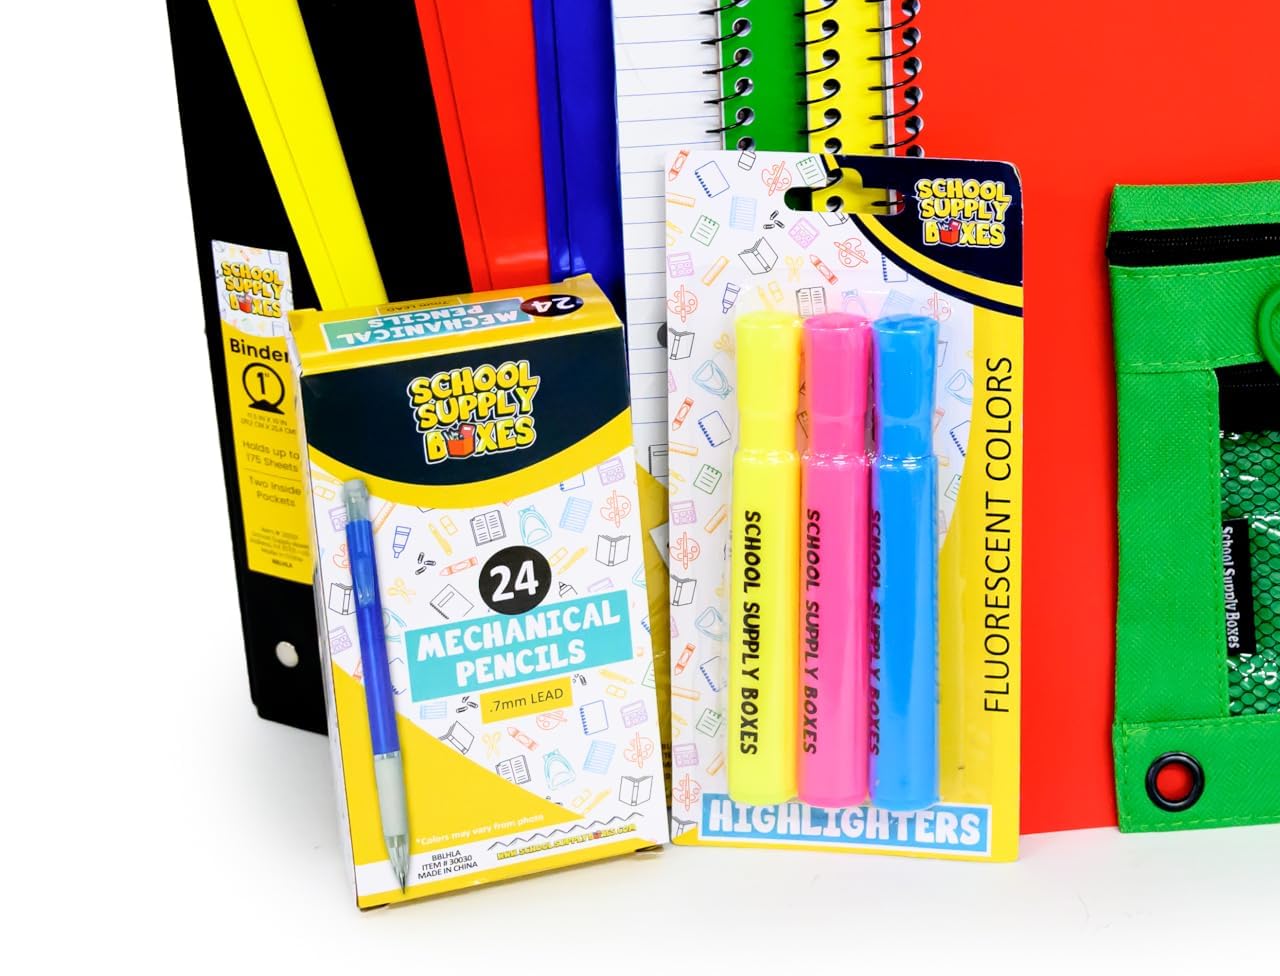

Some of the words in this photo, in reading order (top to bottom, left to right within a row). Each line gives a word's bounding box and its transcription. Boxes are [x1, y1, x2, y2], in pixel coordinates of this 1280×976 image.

[915, 178, 1012, 204] SCHOOL
[920, 198, 1008, 223] SUPPLY
[221, 261, 284, 286] SCHOOL
[224, 277, 284, 300] SUPPLY
[367, 304, 484, 329] PENCILS
[532, 294, 576, 311] 24
[336, 310, 519, 346] MECHANICAL
[408, 361, 540, 407] SCHOOL
[416, 386, 537, 431] SUPPLY
[985, 356, 1013, 482] COLORS
[242, 440, 270, 454] Holds
[272, 449, 287, 459] up
[289, 451, 300, 460] to
[246, 453, 261, 464] 175
[264, 457, 299, 473] Sheets
[248, 476, 269, 488] Two
[256, 490, 296, 507] Pockets
[742, 510, 761, 593] SCHOOL
[805, 510, 821, 592] SCHOOL
[870, 510, 881, 592] SCHOOL
[1222, 526, 1234, 566] School
[489, 559, 539, 602] 24
[983, 491, 1012, 713] FLUORESCENT
[416, 599, 621, 662] MECHANICAL
[741, 601, 761, 681] SUPPLY
[804, 601, 820, 681] SUPPLY
[870, 601, 881, 681] SUPPLY
[1226, 612, 1240, 649] Boxes
[455, 639, 586, 687] PENCILS
[489, 698, 527, 713] .7mm
[530, 688, 564, 705] LEAD
[740, 686, 760, 756] BOXES
[803, 686, 819, 756] BOXES
[869, 686, 881, 756] BOXES
[451, 830, 471, 840] may
[472, 826, 491, 836] vary
[493, 820, 516, 831] from
[517, 814, 544, 828] photo
[708, 798, 981, 845] HIGHLIGHTERS
[417, 869, 442, 880] MADE
[443, 866, 452, 874] IN
[453, 861, 478, 872] CHINA
[421, 861, 442, 872] ITEM
[449, 855, 473, 866] 30030
[431, 850, 462, 862] BBLHLA
